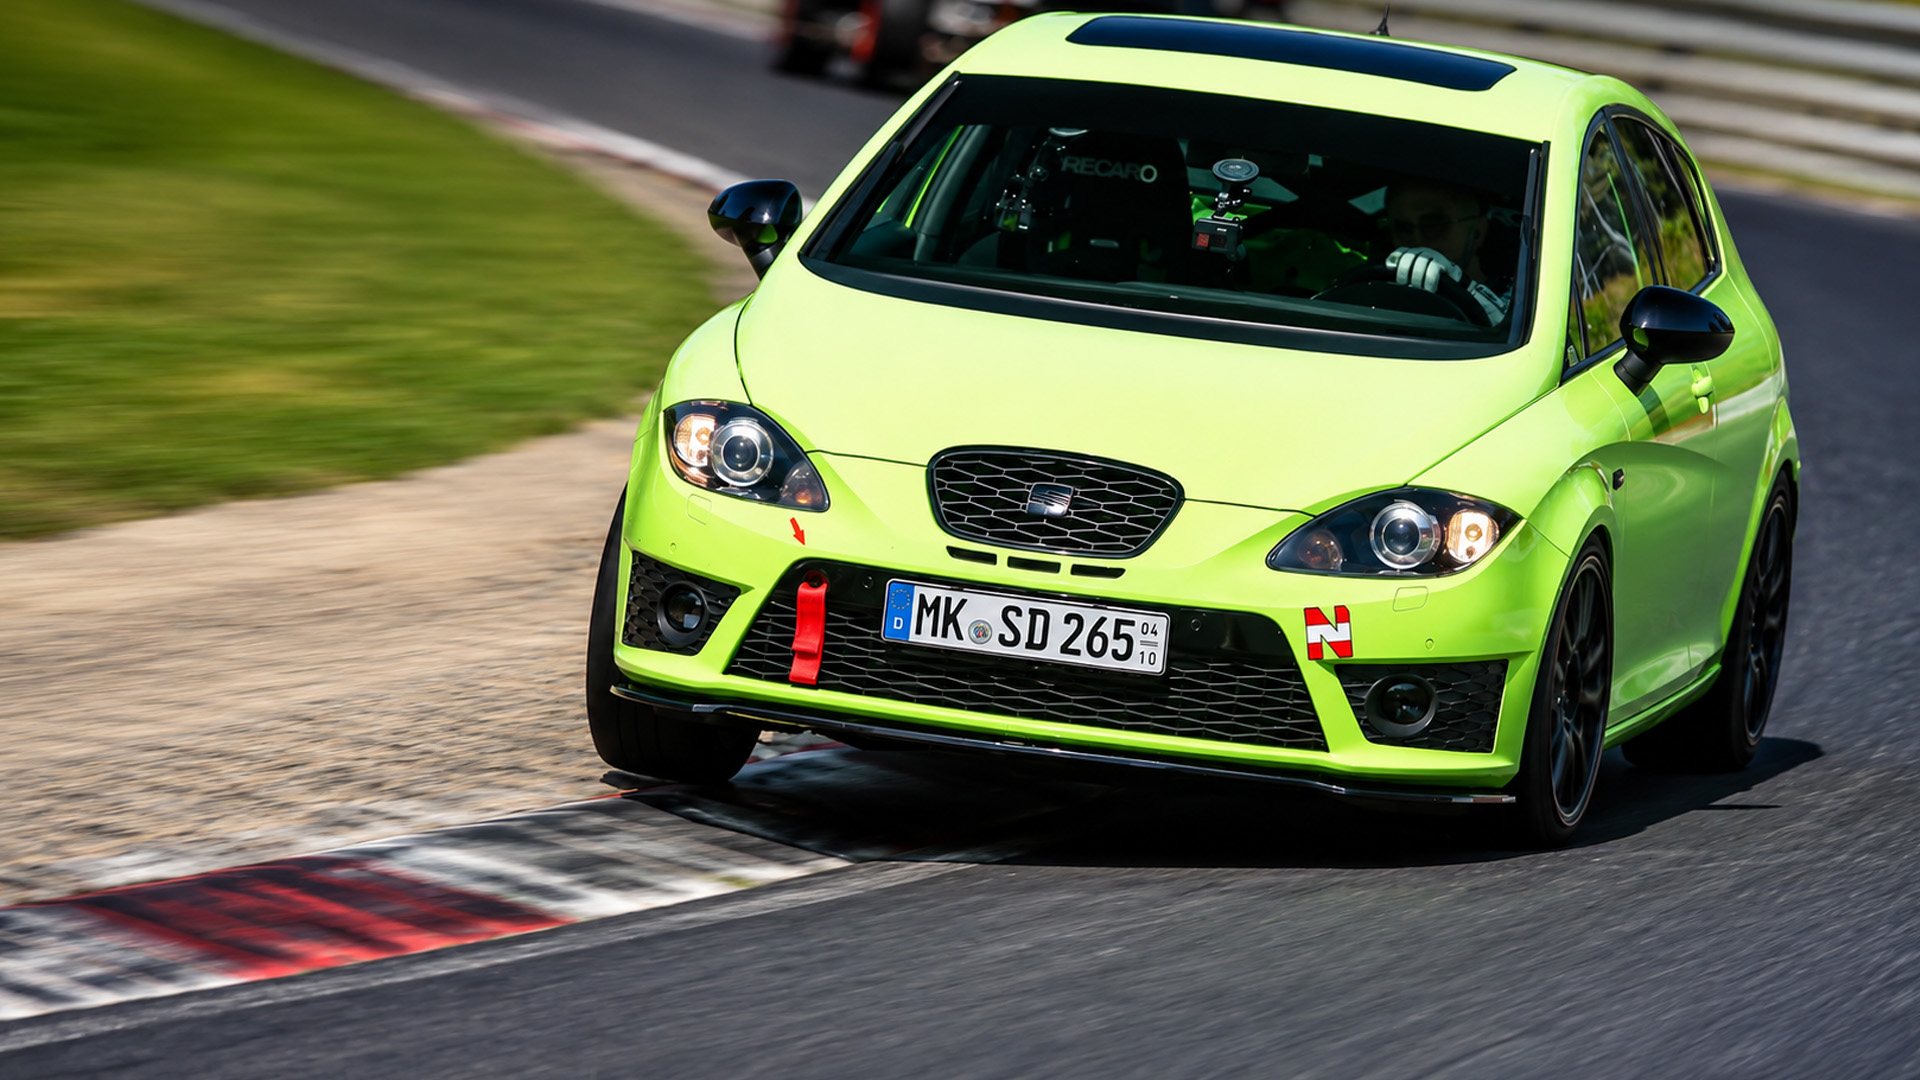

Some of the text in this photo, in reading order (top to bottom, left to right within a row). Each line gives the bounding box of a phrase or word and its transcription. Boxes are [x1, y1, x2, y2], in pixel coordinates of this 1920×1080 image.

[1061, 155, 1158, 183] RECARO
[893, 616, 904, 630] D
[915, 594, 1136, 662] MK SD 265
[1141, 622, 1158, 637] 04
[1303, 605, 1353, 660] N
[1140, 651, 1156, 665] 10
